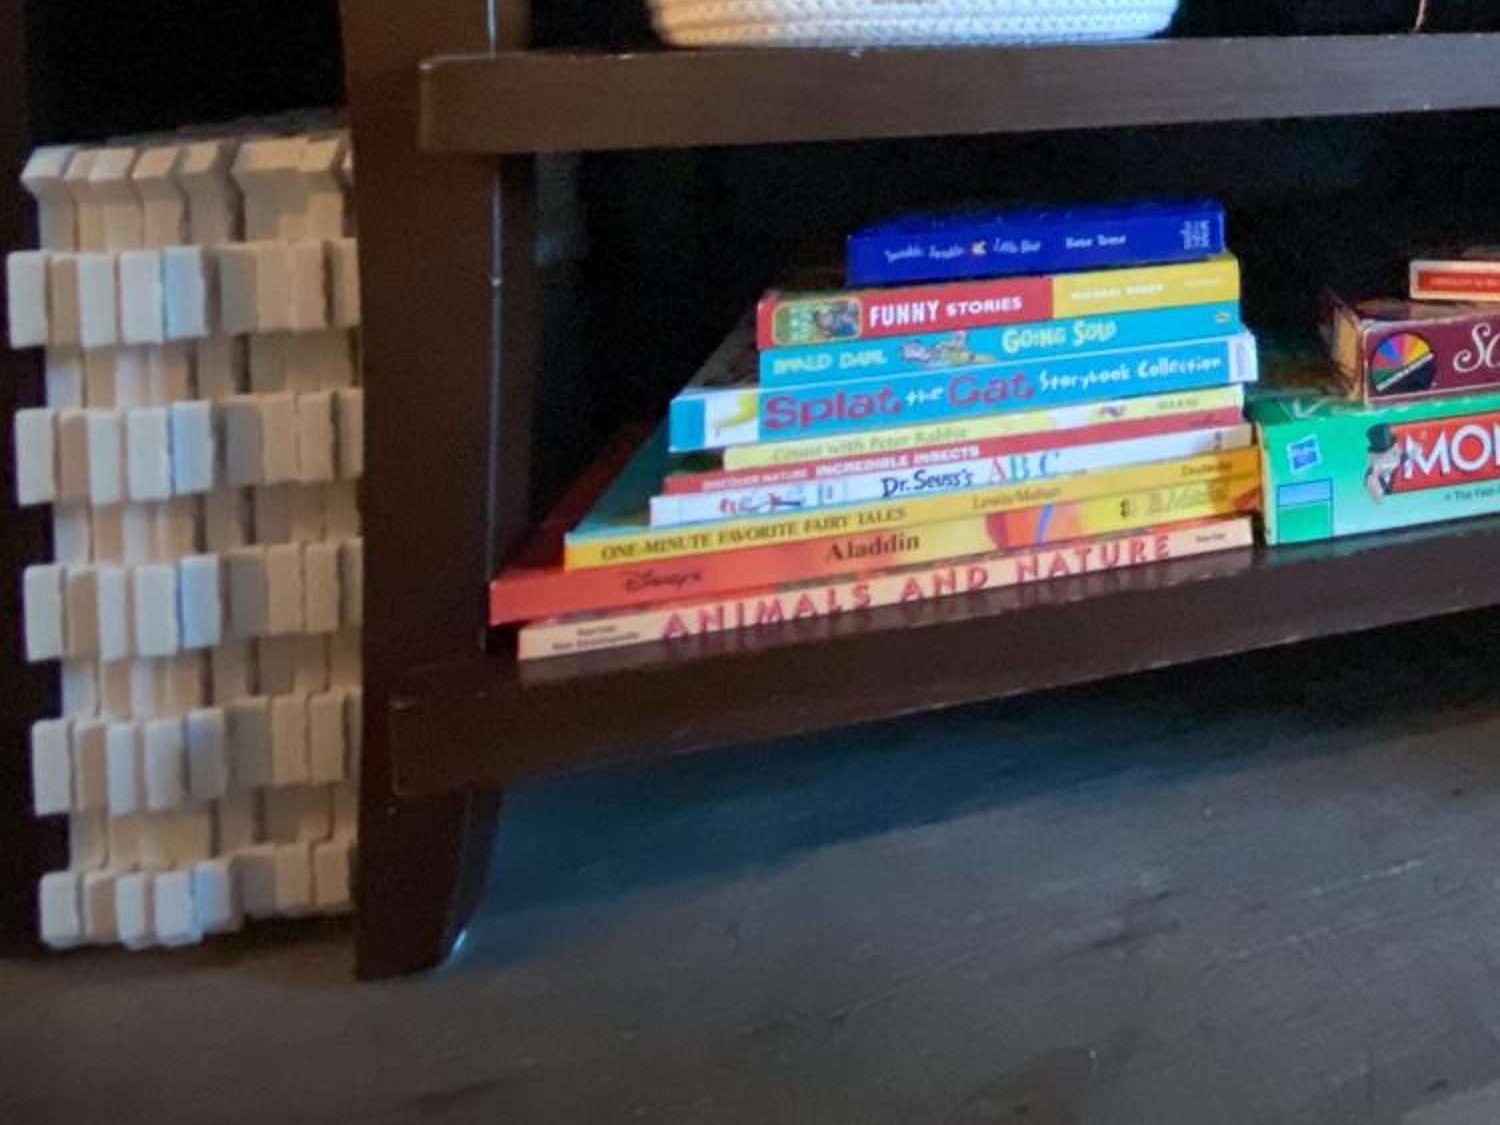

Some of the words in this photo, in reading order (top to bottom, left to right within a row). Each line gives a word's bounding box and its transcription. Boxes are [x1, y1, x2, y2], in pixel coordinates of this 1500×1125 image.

[869, 299, 940, 328] FUNNY
[945, 296, 1023, 316] STORIES
[1002, 328, 1067, 353] GOING
[1072, 318, 1117, 346] SOLO
[773, 353, 832, 375] ROALD
[839, 349, 888, 369] DAHL
[764, 386, 903, 429] Splat
[906, 386, 944, 406] the
[948, 372, 1034, 406] Cat
[1039, 363, 1130, 393] Storybook
[1137, 356, 1222, 377] Collection
[870, 434, 912, 451] Peter
[815, 453, 909, 475] INCREDIBLE
[913, 444, 980, 464] INSECTS
[913, 467, 974, 489] Seuss's
[600, 529, 712, 560] ONE-MINUTE
[719, 521, 796, 545] FAVORITE
[803, 515, 849, 533] FAIRY
[858, 506, 907, 525] TALES
[828, 534, 920, 560] Aladdin
[663, 583, 872, 640] ANIMALS
[899, 567, 990, 602] AND
[1015, 535, 1170, 585] NATURE
